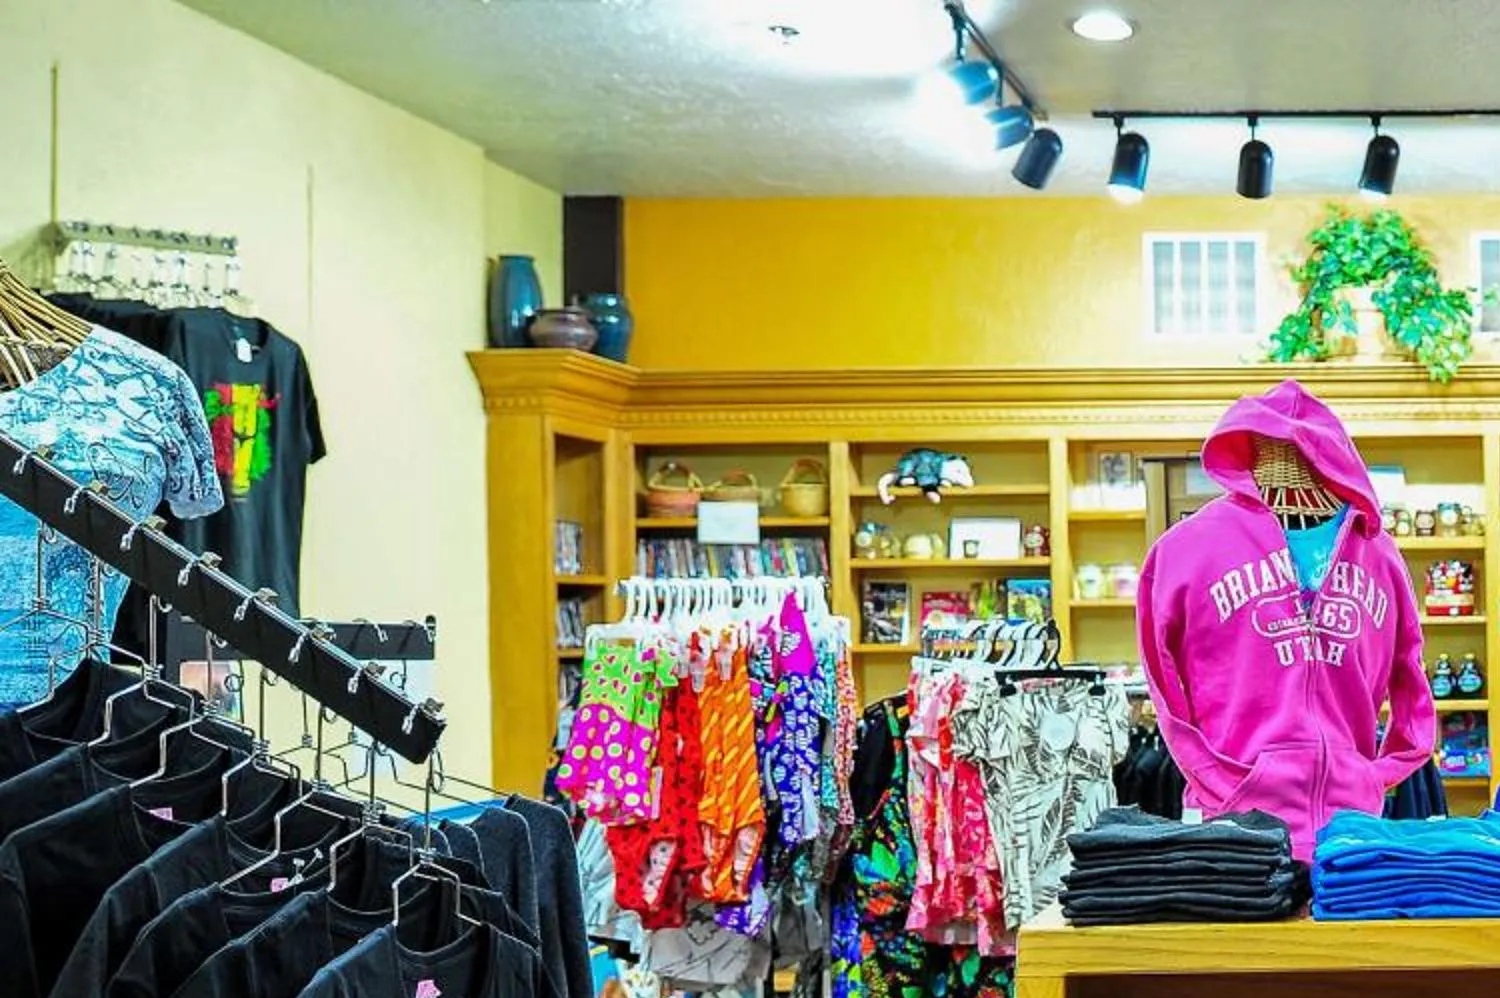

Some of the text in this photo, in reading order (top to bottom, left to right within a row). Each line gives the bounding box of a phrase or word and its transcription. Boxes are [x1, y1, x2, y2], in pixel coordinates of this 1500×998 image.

[1209, 547, 1297, 624] BRIAN
[1331, 560, 1388, 630] HEAD
[1273, 635, 1347, 667] UTAH
